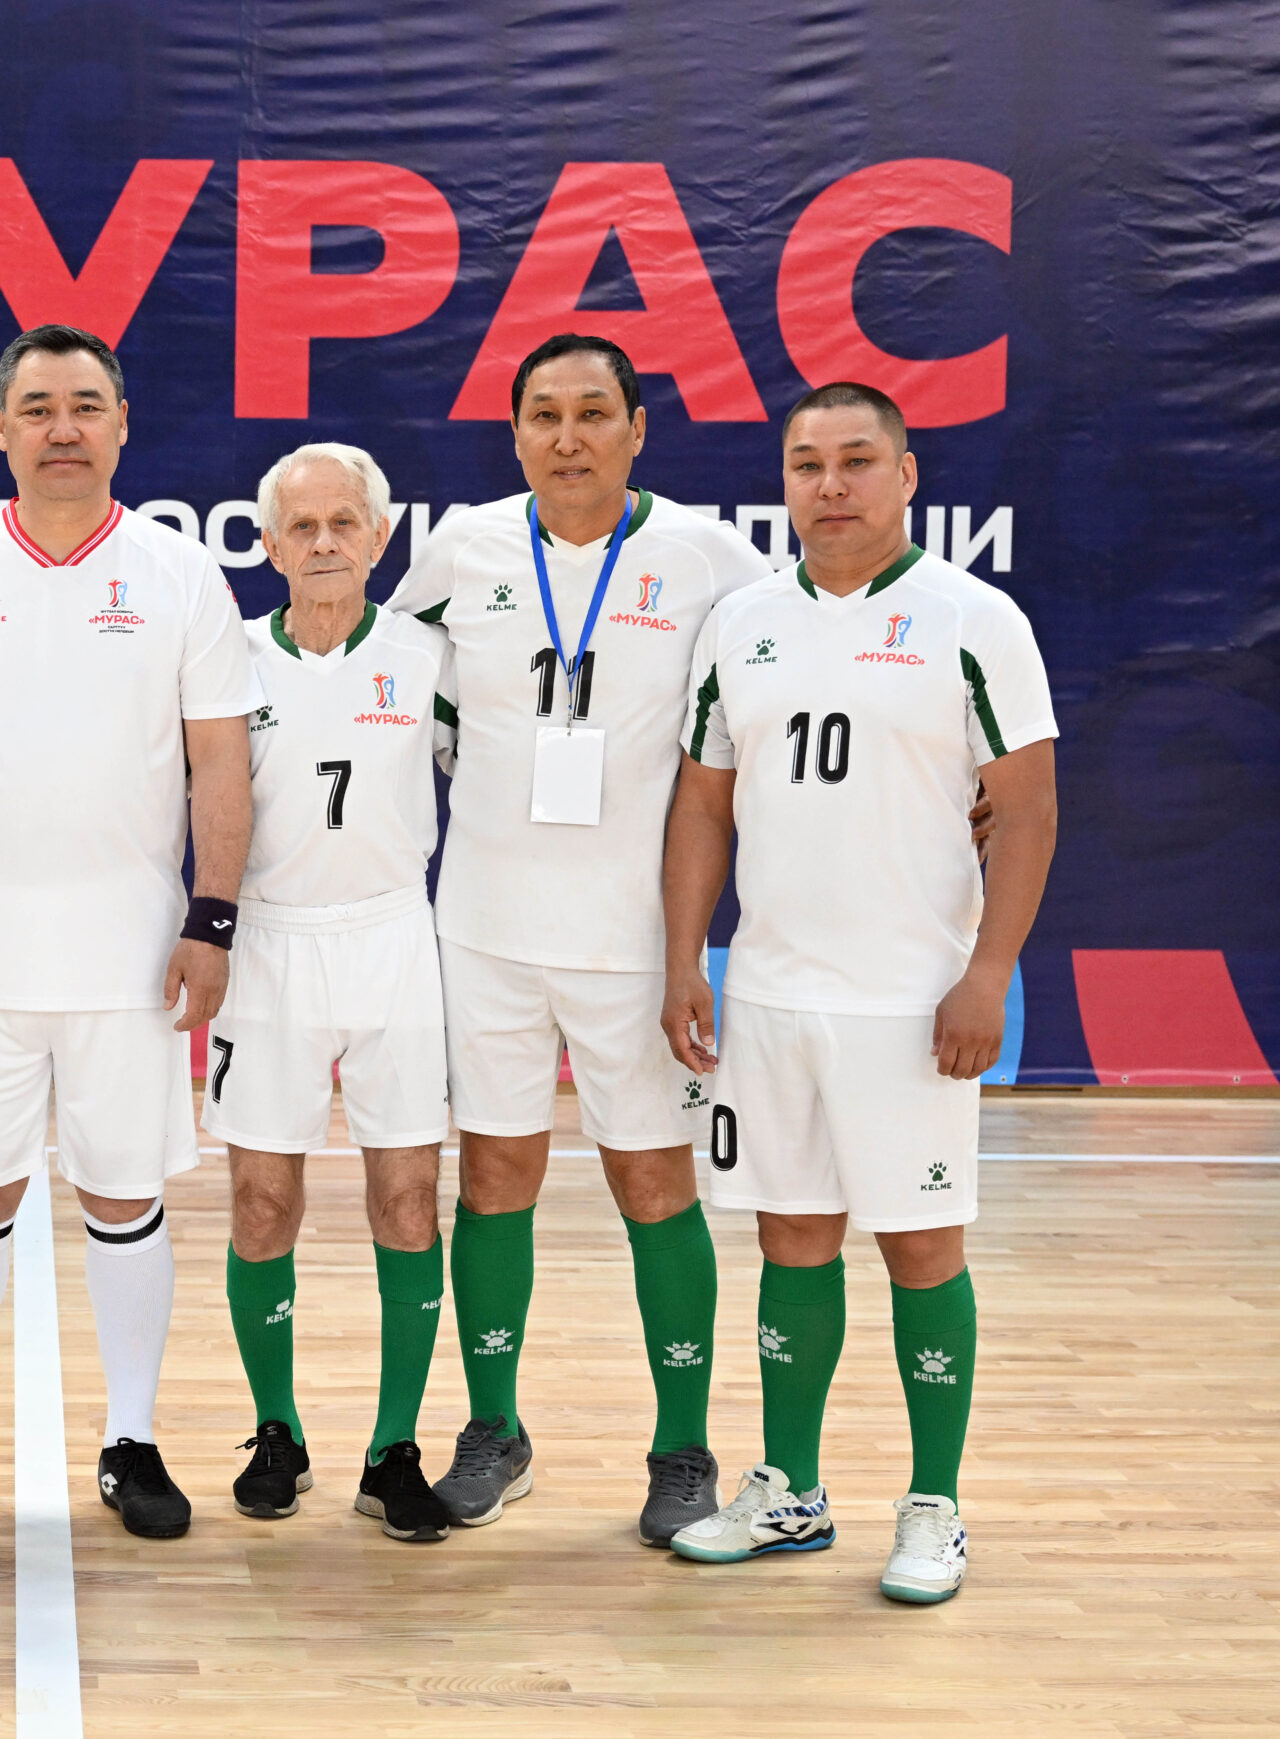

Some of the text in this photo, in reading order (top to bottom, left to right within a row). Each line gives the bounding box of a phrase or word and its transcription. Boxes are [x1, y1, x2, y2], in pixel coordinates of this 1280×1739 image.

[487, 603, 518, 611] KELME
[88, 614, 145, 624] «МУРАС»
[609, 612, 677, 631] «МУРАС»
[745, 656, 777, 665] KELME
[854, 652, 925, 666] «МУРАС»
[530, 647, 595, 720] 11
[250, 719, 279, 732] KELME
[354, 713, 418, 725] «МУРАС»
[787, 712, 851, 784] 10
[316, 760, 351, 829] 7
[212, 1034, 234, 1104] 7
[681, 1098, 710, 1110] KELME
[920, 1182, 952, 1191] KELME
[266, 1306, 293, 1325] KELM
[474, 1344, 514, 1355] KELME
[759, 1346, 793, 1363] ELME
[663, 1356, 704, 1367] KELME
[913, 1370, 957, 1385] KELME
